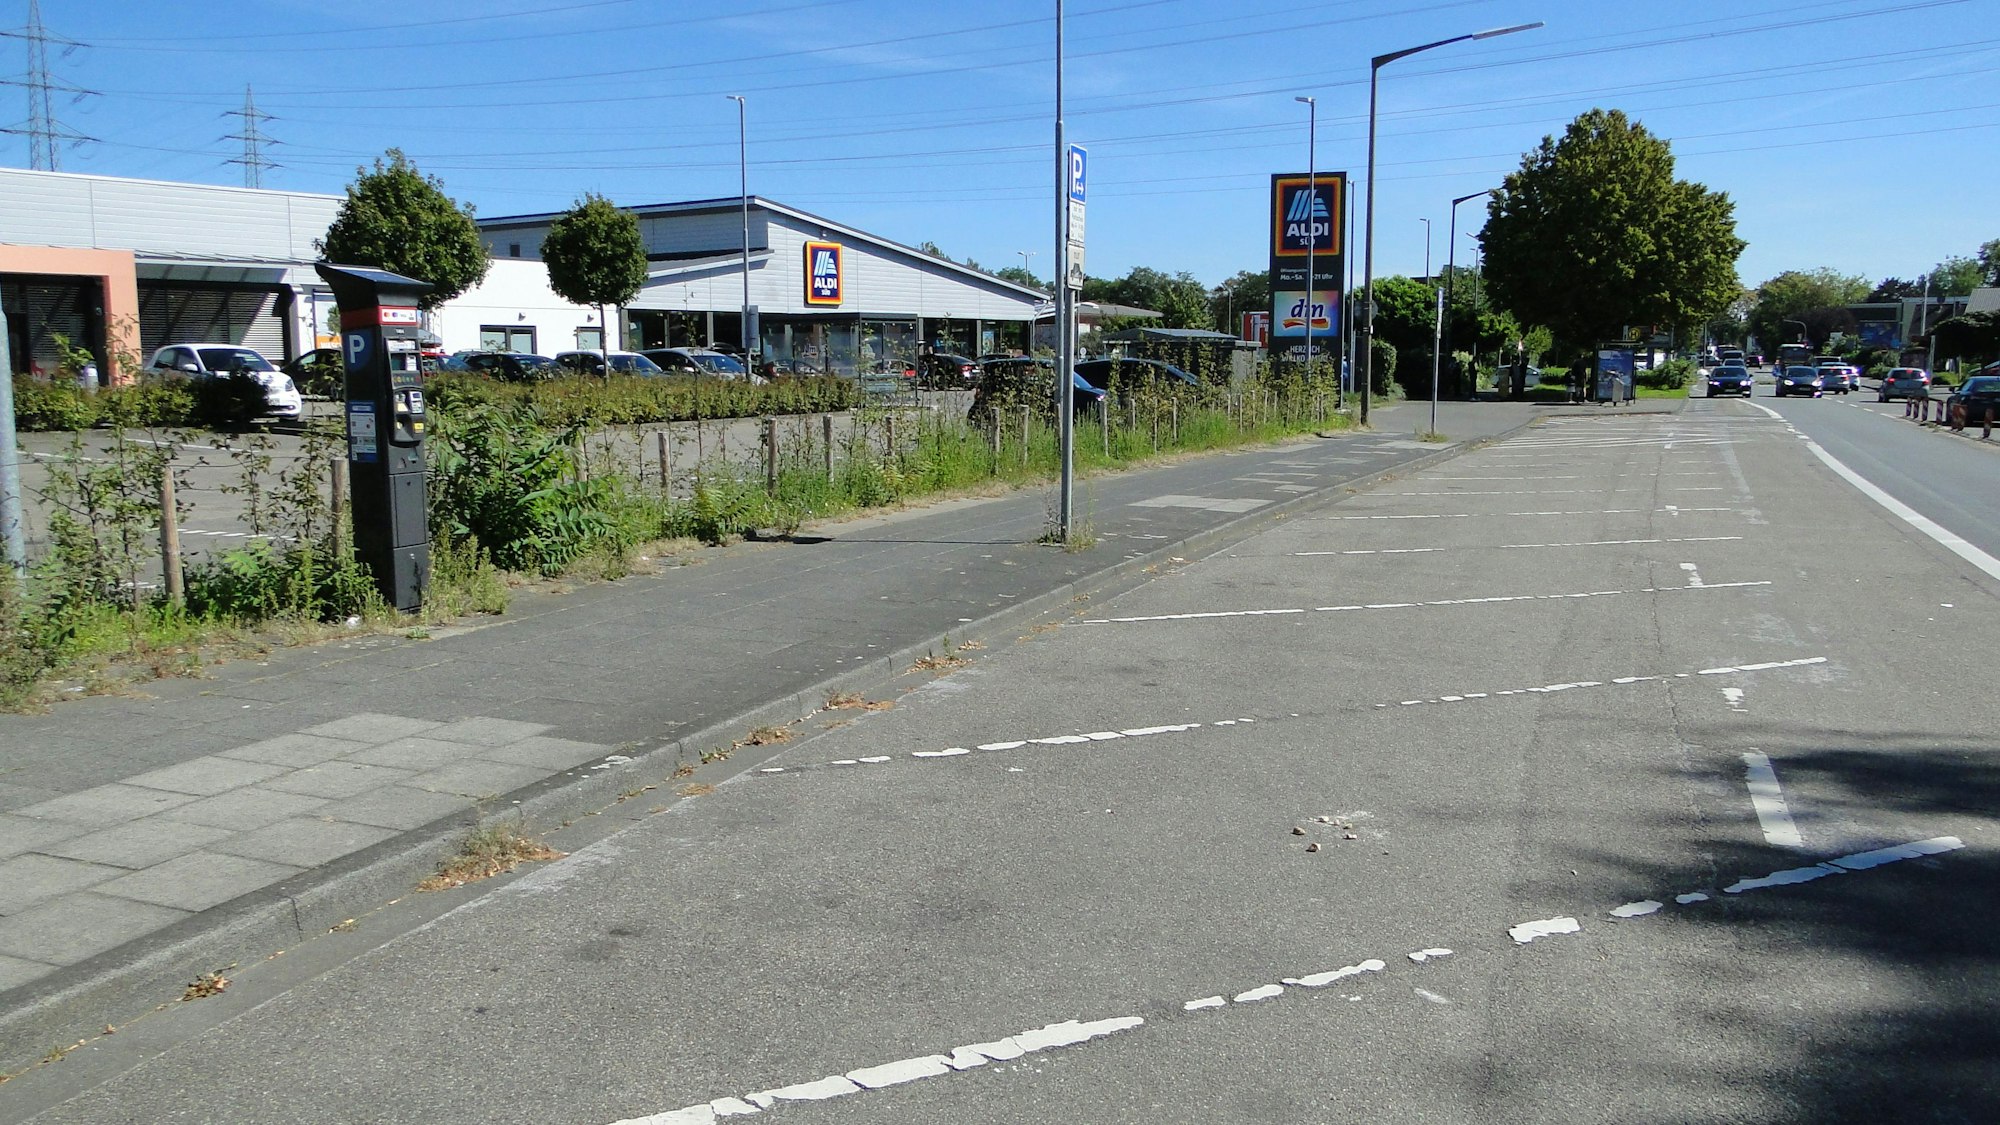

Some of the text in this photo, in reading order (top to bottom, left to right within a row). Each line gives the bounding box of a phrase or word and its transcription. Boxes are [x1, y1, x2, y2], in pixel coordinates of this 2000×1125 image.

[1072, 152, 1083, 193] P
[1286, 223, 1329, 237] ALDI
[814, 277, 837, 289] ALDI
[1291, 299, 1324, 317] dm
[348, 335, 365, 364] P
